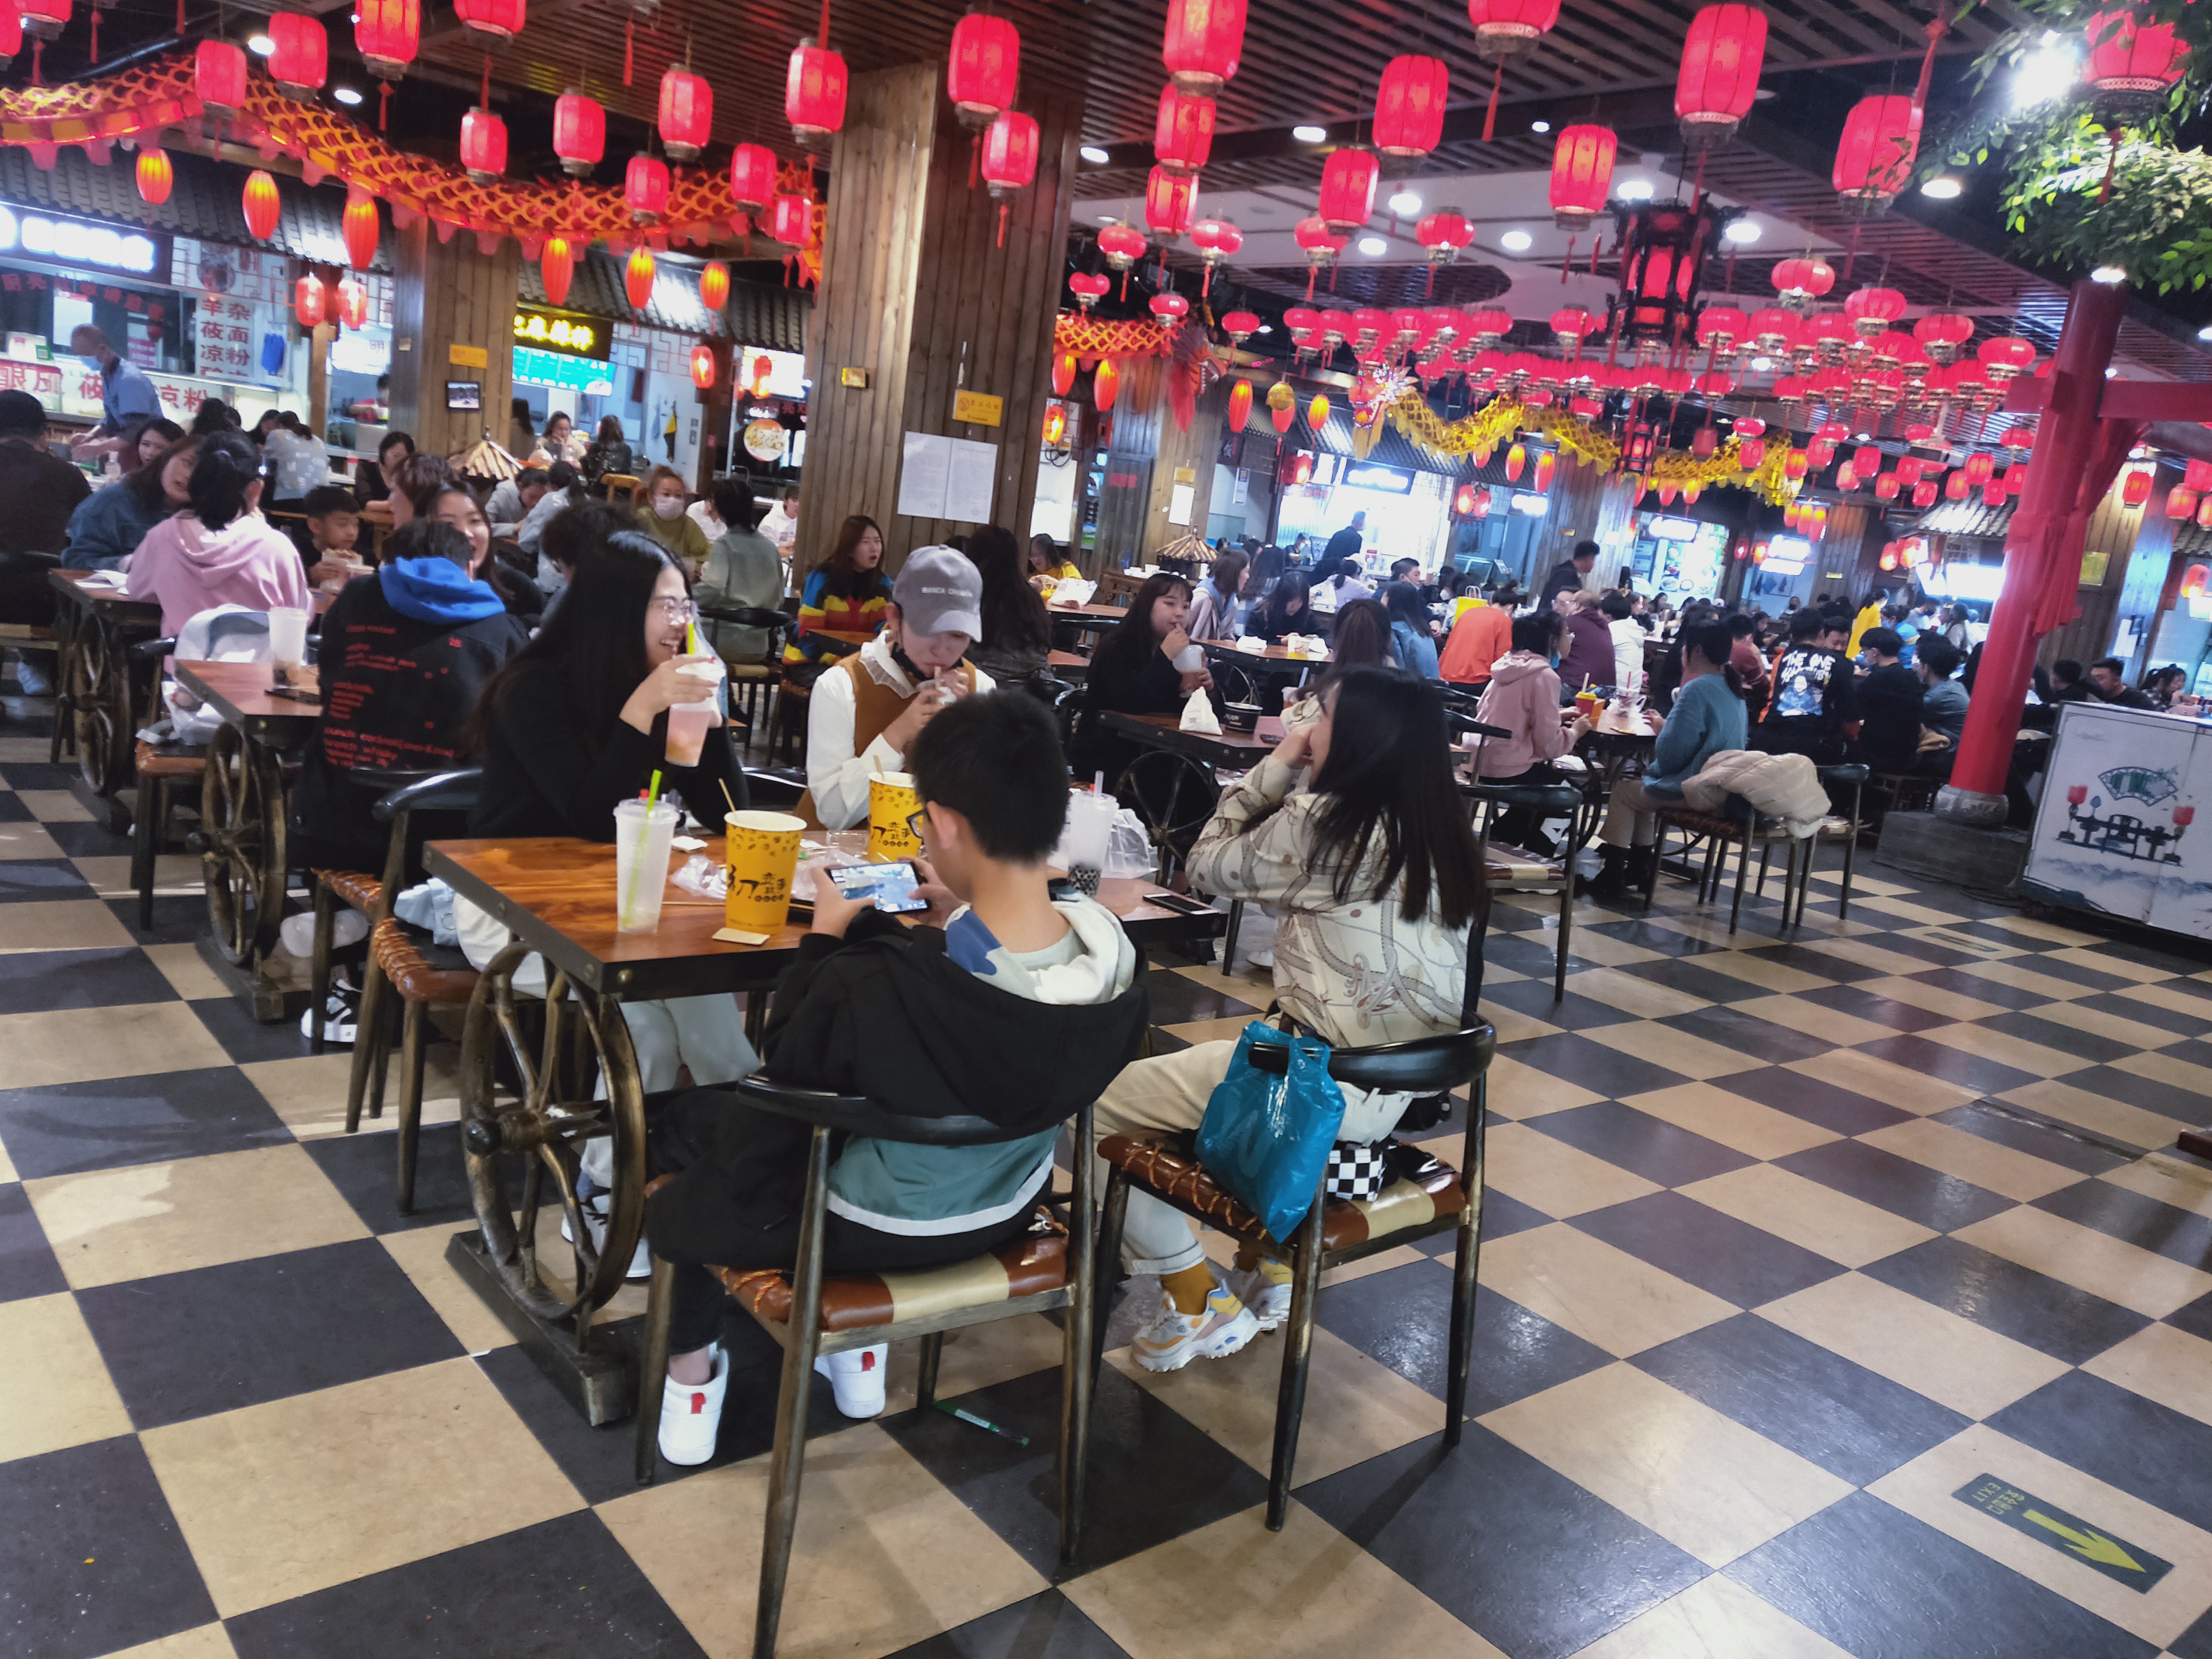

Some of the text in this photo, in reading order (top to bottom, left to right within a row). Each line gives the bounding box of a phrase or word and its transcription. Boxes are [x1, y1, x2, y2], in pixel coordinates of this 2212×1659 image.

[201, 299, 251, 321] 羊杂
[201, 321, 250, 344] 莜面
[201, 344, 250, 366] 凉粉
[1782, 649, 1836, 671] THE ONE
[1972, 1482, 2001, 1503] EXIT
[1986, 1490, 2025, 1515] 安全出口
